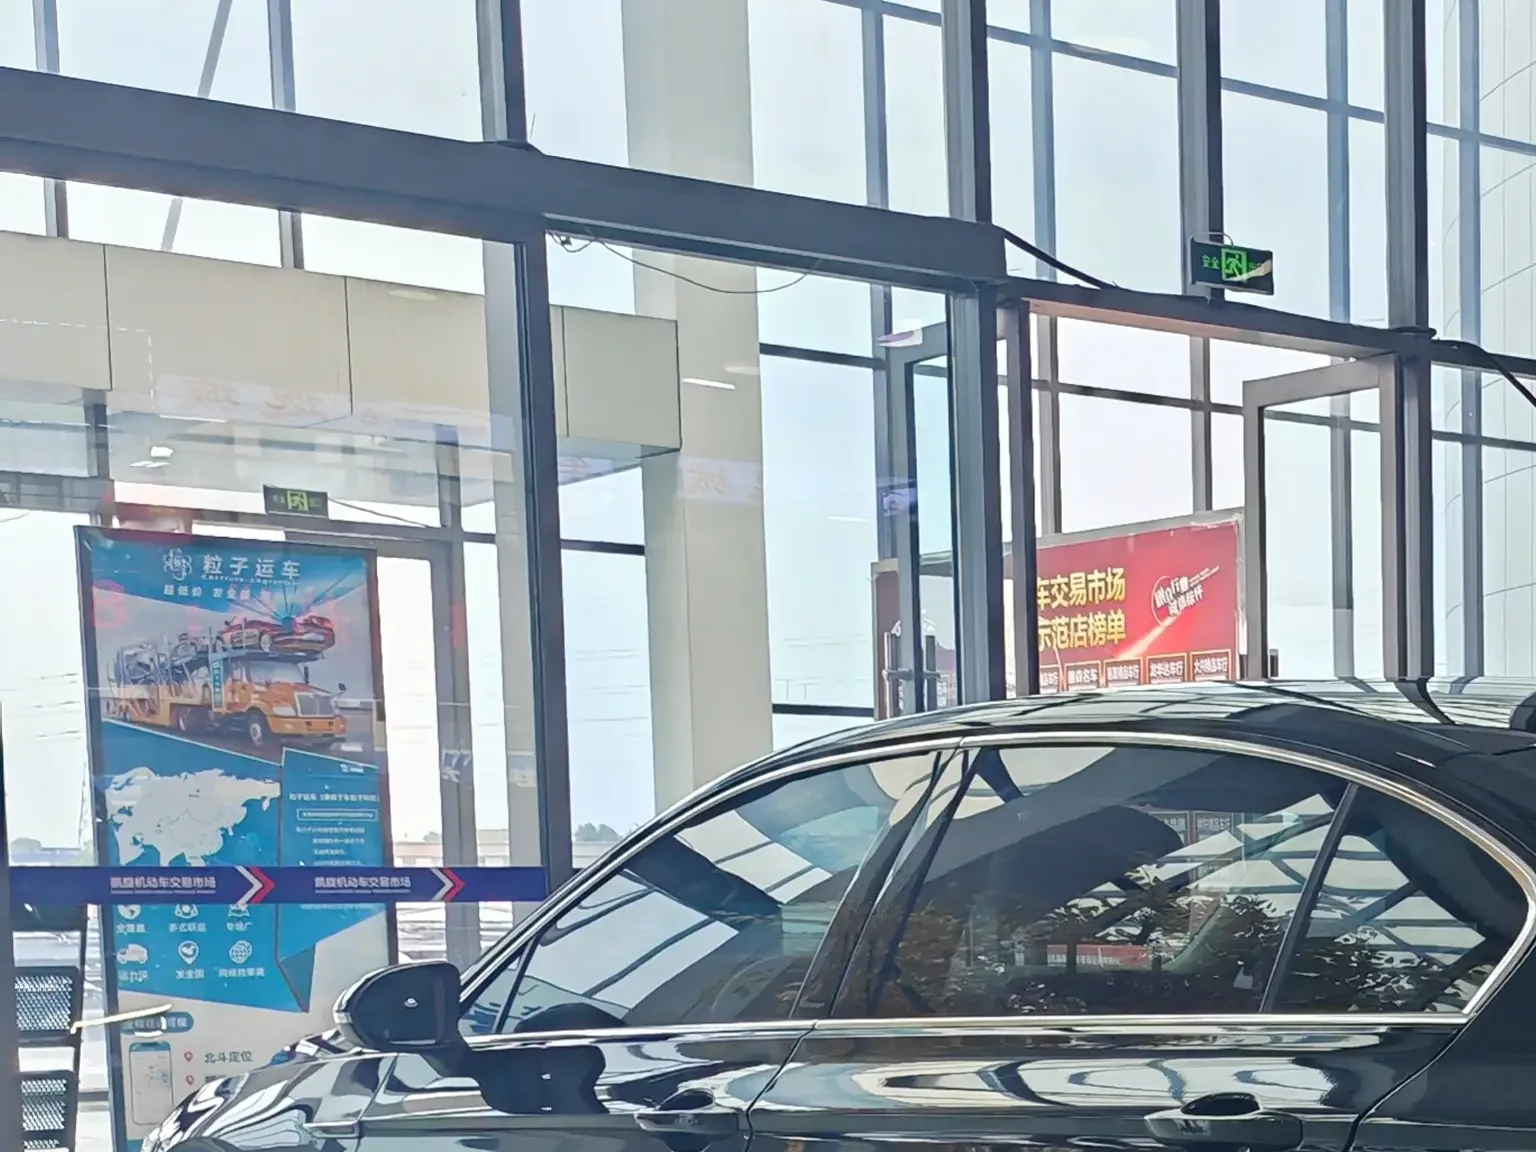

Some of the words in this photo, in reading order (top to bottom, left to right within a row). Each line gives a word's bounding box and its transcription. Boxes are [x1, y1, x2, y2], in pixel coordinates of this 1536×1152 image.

[202, 554, 301, 579] 粒子运车
[1037, 567, 1126, 611] 车交易市场
[1038, 608, 1126, 652] 示范店榜单
[204, 1051, 253, 1063] 北斗定位
